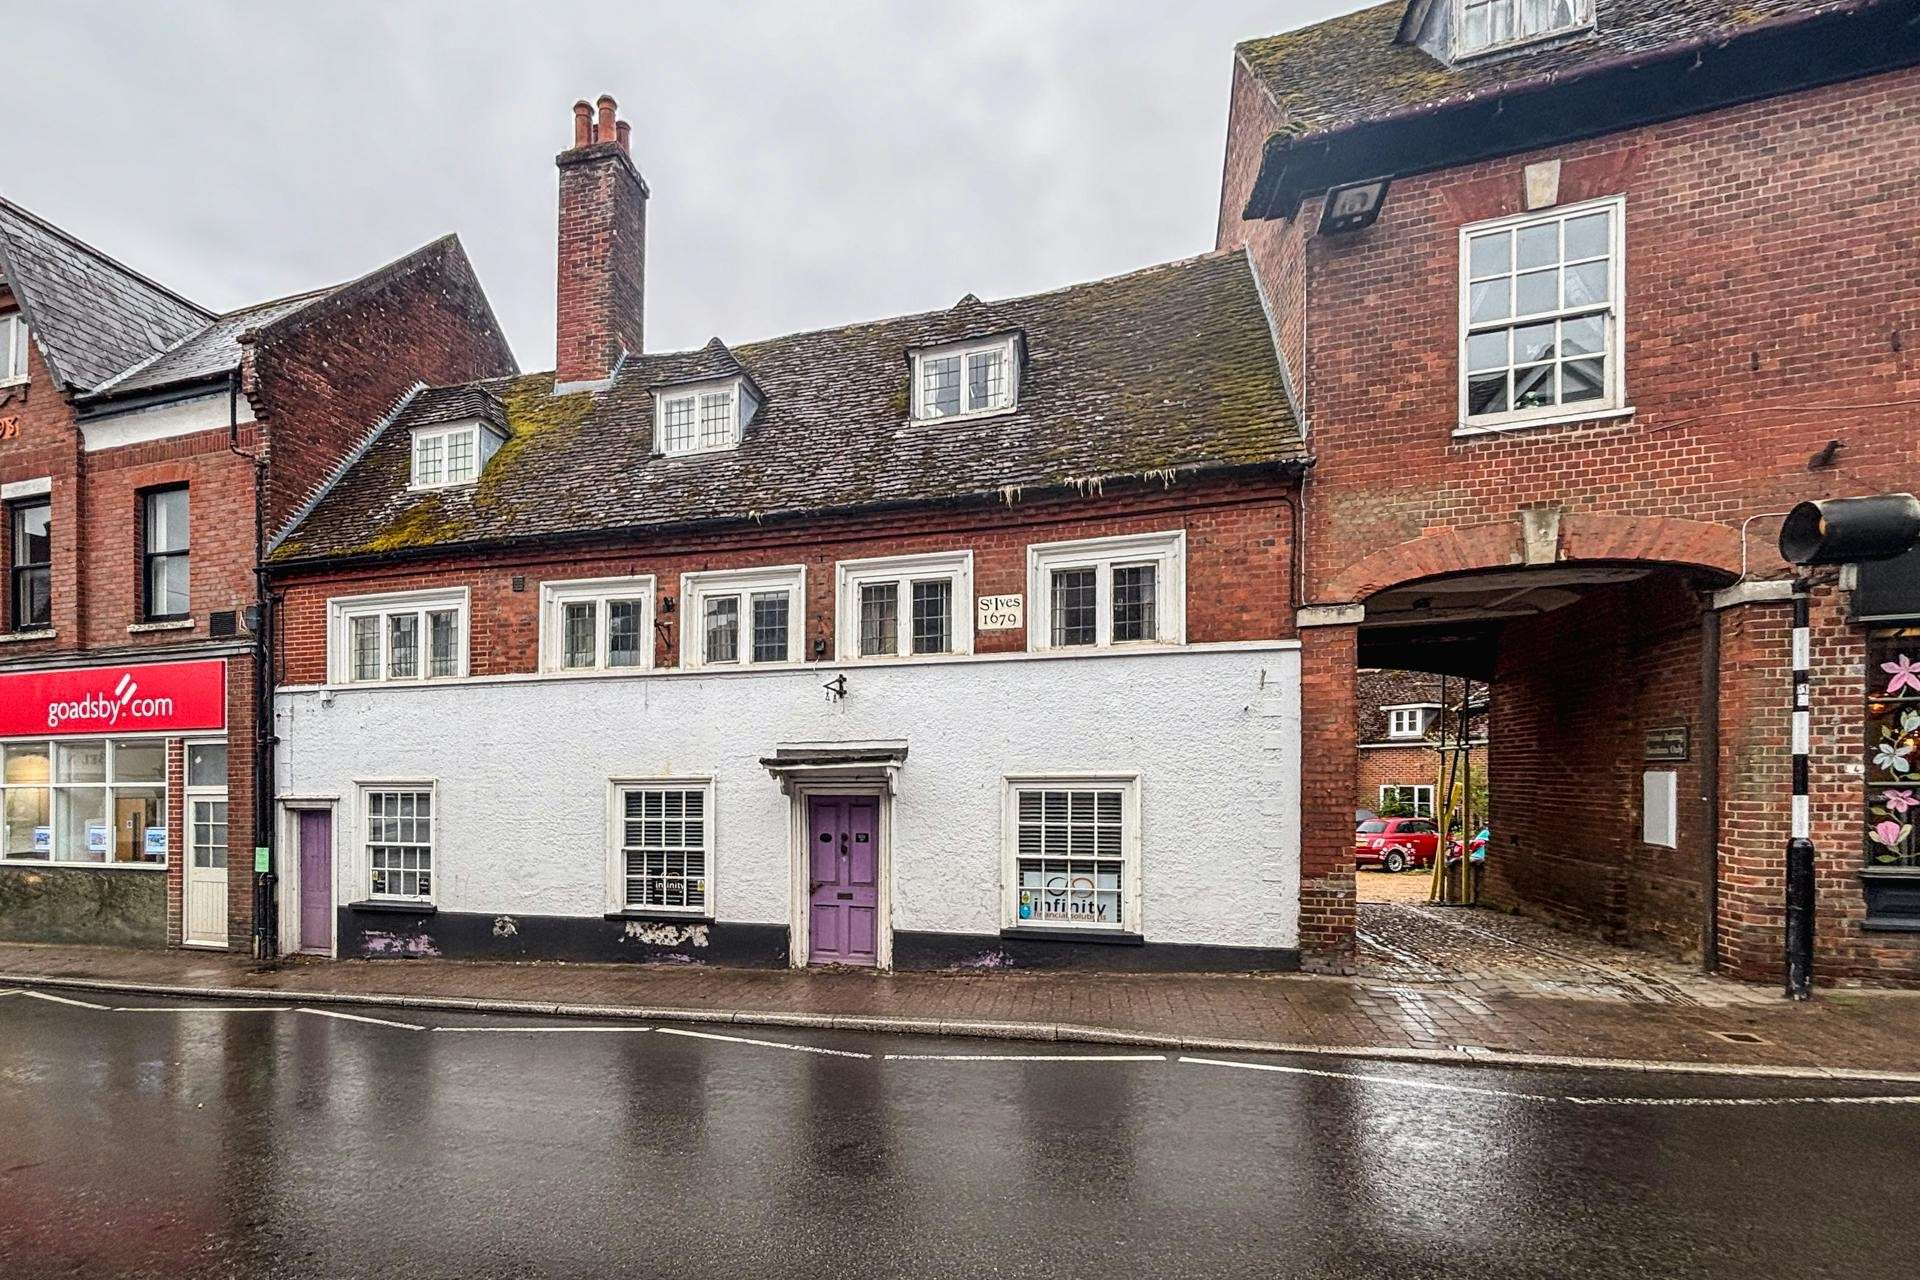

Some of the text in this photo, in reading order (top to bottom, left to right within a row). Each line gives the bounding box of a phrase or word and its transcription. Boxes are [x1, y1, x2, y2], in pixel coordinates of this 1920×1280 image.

[984, 612, 1016, 625] 1679
[47, 691, 173, 728] goadsby.com
[1034, 897, 1107, 916] infinity
